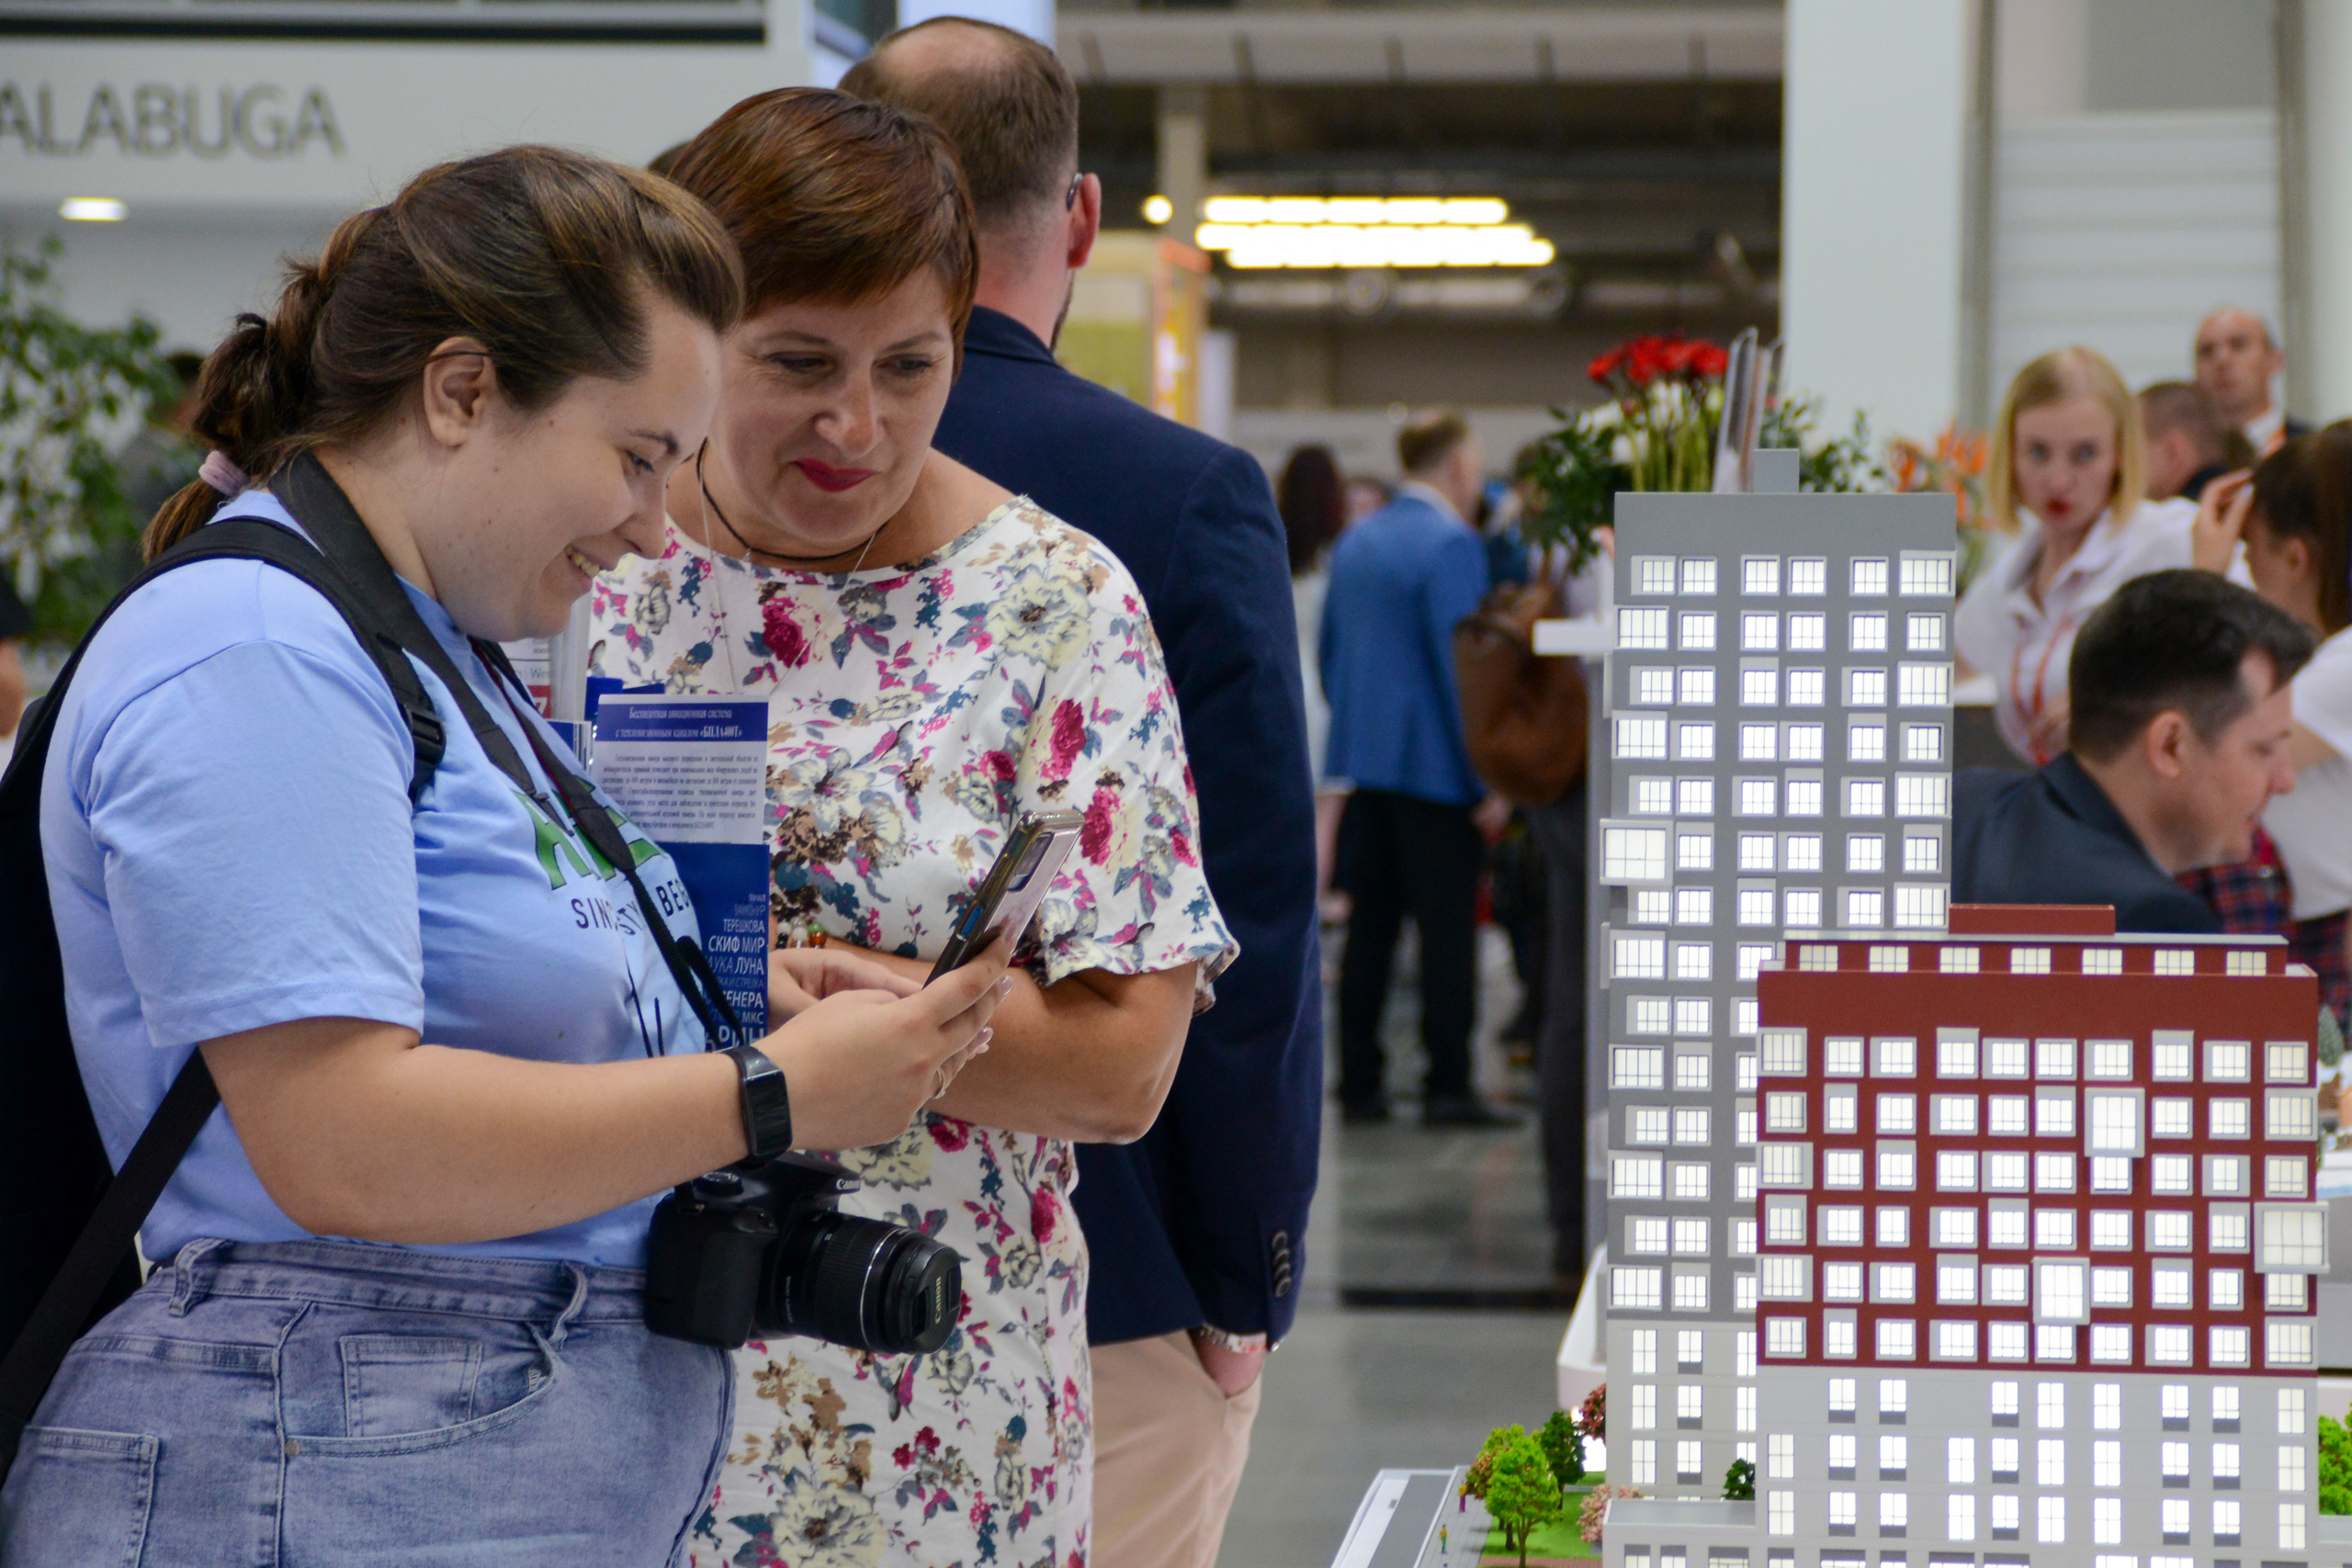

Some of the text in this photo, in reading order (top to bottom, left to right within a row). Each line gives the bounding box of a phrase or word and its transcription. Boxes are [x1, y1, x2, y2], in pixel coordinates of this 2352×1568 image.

[0, 81, 349, 160] ALABUGA
[708, 935, 765, 953] СКИФ МИР
[707, 956, 764, 975] АУКА ЛУНА
[723, 990, 763, 1009] ЕНЕРА
[741, 1011, 763, 1024] МКС
[836, 1179, 861, 1190] Canon
